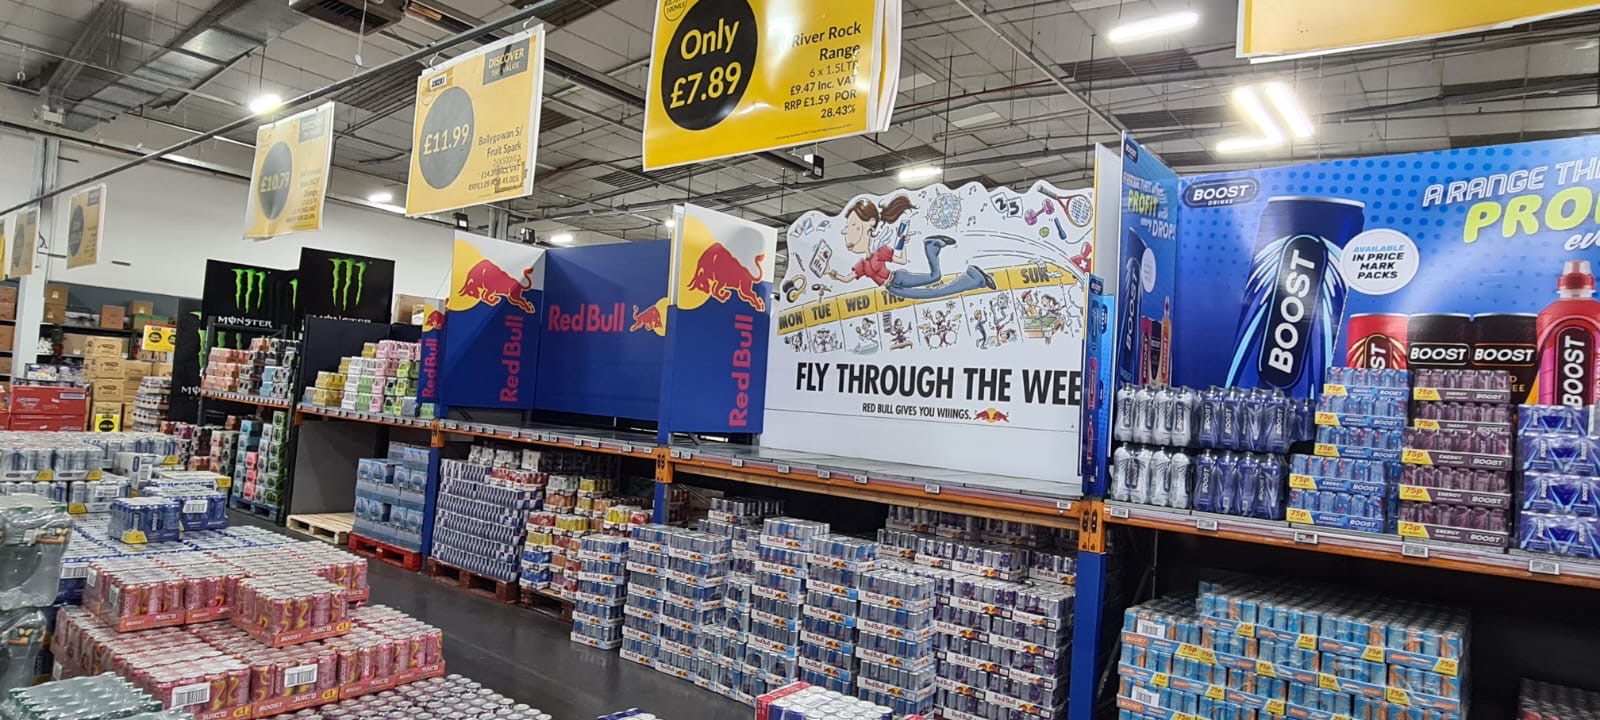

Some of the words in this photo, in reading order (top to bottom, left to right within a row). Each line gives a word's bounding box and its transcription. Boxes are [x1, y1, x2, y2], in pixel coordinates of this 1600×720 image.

[681, 17, 739, 60] Only
[792, 29, 825, 47] River
[828, 21, 862, 40] Rock
[488, 48, 525, 69] DISCOVER
[819, 44, 861, 61] Range
[503, 61, 520, 74] VALUE
[809, 69, 816, 78] 6
[669, 61, 742, 110] £7.89
[790, 82, 816, 96] £9.47
[817, 79, 834, 90] Inc.
[837, 75, 857, 88] VAT
[784, 99, 802, 112] RRP
[803, 94, 830, 108] £1.59
[834, 89, 857, 101] POR
[820, 104, 856, 119] 28.43%
[424, 123, 470, 155] £11.99
[478, 131, 514, 146] Ballygowan
[487, 146, 502, 158] Fruit
[503, 140, 522, 154] Spark
[1422, 184, 1444, 208] A
[1446, 165, 1549, 204] RANGE
[1554, 157, 1600, 187] TH
[1128, 188, 1159, 217] PROFIT
[1192, 184, 1250, 202] BOOST
[1463, 184, 1600, 244] PRO
[1152, 220, 1176, 240] DROP!
[1351, 244, 1406, 253] AVAILABLE
[1351, 252, 1366, 262] IN
[1366, 251, 1405, 262] PRICE
[1357, 270, 1399, 280] PACKS
[1359, 261, 1395, 271] MARK
[547, 305, 584, 332] Red
[586, 302, 625, 332] Bull
[779, 311, 803, 330] MON
[812, 304, 832, 321] TUE
[845, 295, 870, 312] WED
[1125, 267, 1138, 351] BOOST
[1267, 249, 1316, 374] BOOST
[504, 315, 524, 357] Bull
[732, 314, 754, 369] Bull
[423, 337, 440, 365] Bull
[1410, 346, 1468, 361] BOOST
[1473, 347, 1535, 362] BOOST
[500, 361, 520, 402] Red
[1562, 335, 1586, 409] BOOST
[421, 366, 439, 399] Red
[795, 362, 830, 392] FLY
[836, 363, 955, 399] THROUGH
[963, 367, 1012, 402] THE
[1327, 385, 1342, 393] 75p
[728, 371, 749, 428] Red
[1418, 388, 1433, 396] 75p
[862, 402, 875, 414] RED
[877, 403, 894, 415] BULL
[895, 404, 918, 417] GIVES
[919, 406, 935, 418] YOU
[1203, 403, 1211, 430] BOOST
[1319, 413, 1334, 421] 75p
[1224, 407, 1232, 434] BOOST
[1276, 407, 1284, 435] BOOST
[1418, 420, 1434, 428] 75p
[1477, 426, 1503, 434] BOOST
[1318, 444, 1333, 452] 75p
[1372, 451, 1398, 459] BOOST
[1406, 450, 1424, 459] 75p
[1472, 457, 1504, 466] BOOST
[1202, 468, 1210, 494] BOOST
[1295, 475, 1310, 484] 75p
[1352, 484, 1379, 493] BOOST
[1405, 486, 1423, 496] 75p
[1471, 495, 1503, 505] BOOST
[1290, 509, 1306, 518] 75p
[1349, 519, 1376, 528] BOOST
[1402, 523, 1421, 532] 75p
[1469, 533, 1501, 543] BOOST
[958, 598, 968, 606] Red
[969, 600, 979, 608] Bull
[998, 636, 1008, 644] Red
[1008, 639, 1020, 647] Bull
[1183, 644, 1198, 653] 75p
[1301, 635, 1313, 643] 75p
[955, 654, 965, 662] Red
[965, 657, 976, 665] Bull
[1440, 659, 1456, 669] 75p
[258, 701, 283, 712] BOOST
[293, 692, 317, 703] JUIC'D
[994, 694, 1004, 702] Red
[1004, 697, 1016, 705] Bull
